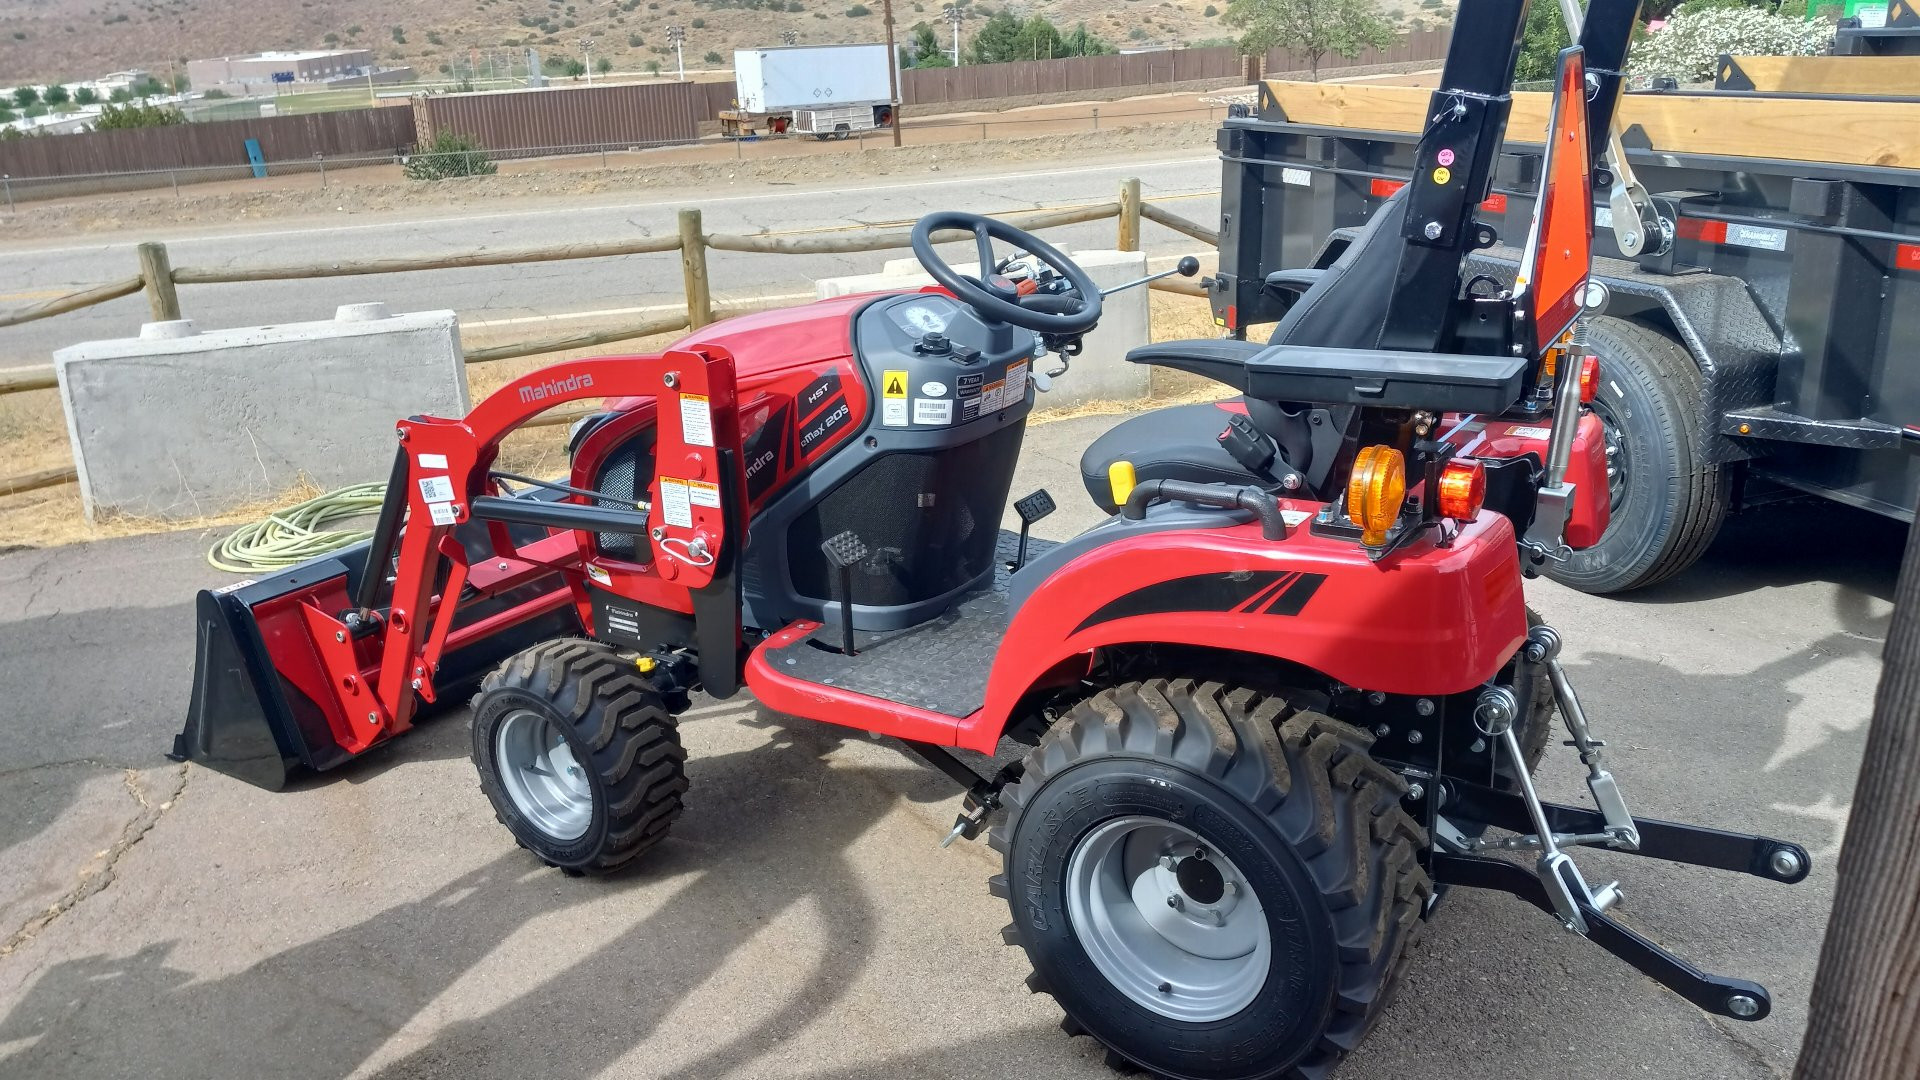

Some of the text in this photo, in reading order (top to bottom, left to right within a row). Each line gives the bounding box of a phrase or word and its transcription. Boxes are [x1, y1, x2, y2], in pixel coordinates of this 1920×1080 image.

[518, 373, 594, 404] Mahindra
[808, 382, 829, 404] HST
[963, 377, 968, 385] 7
[825, 404, 849, 428] 20S
[1024, 786, 1095, 932] CARLISLE
